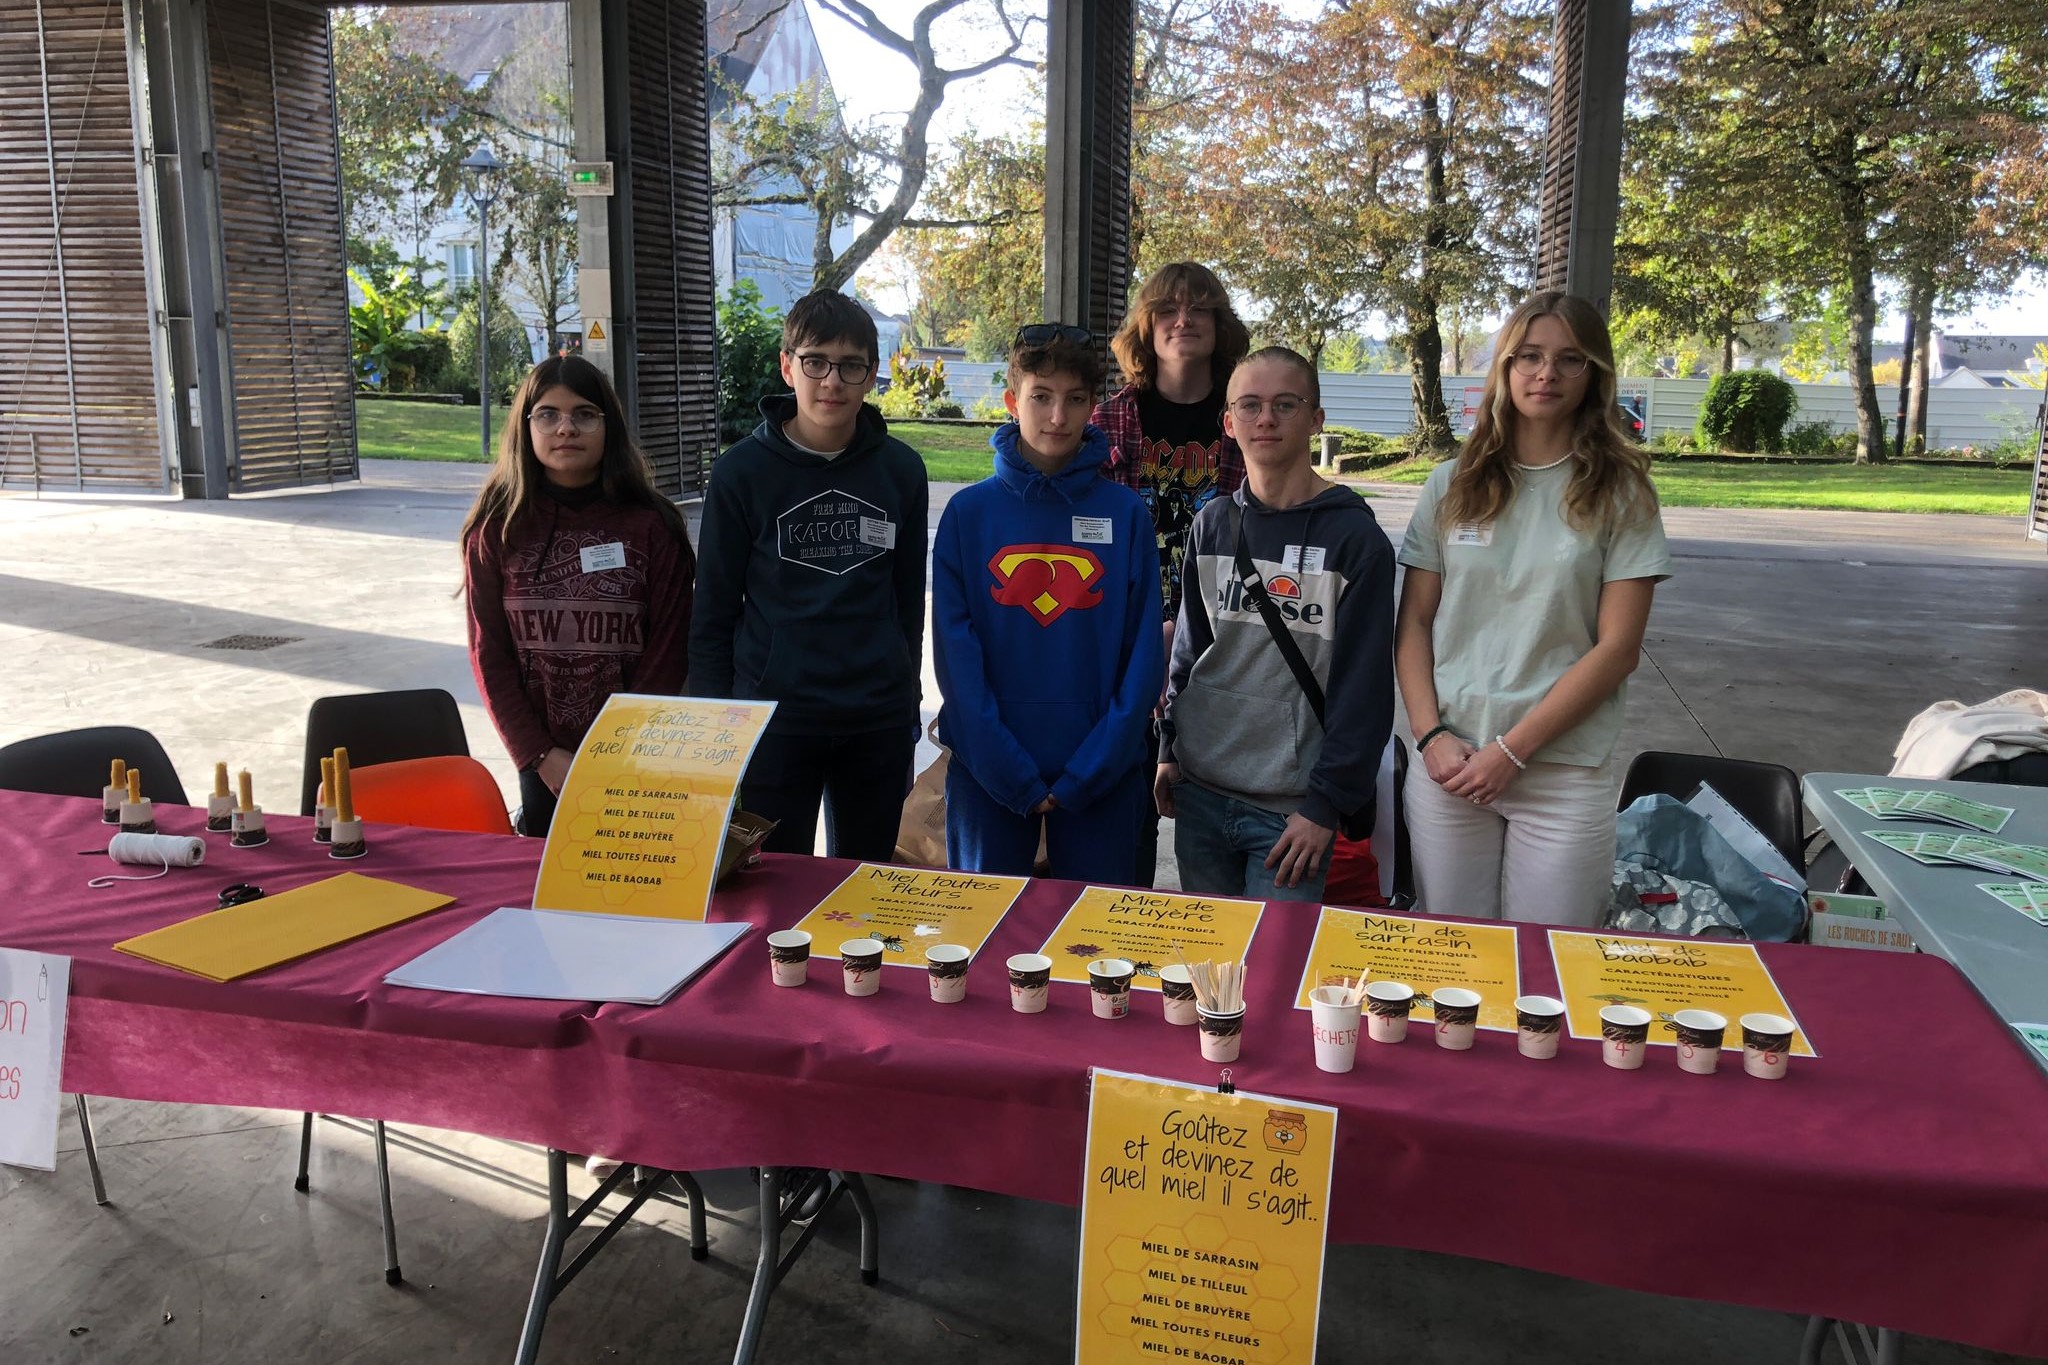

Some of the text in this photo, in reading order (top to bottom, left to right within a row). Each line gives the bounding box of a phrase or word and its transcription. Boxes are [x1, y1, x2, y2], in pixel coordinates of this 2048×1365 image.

[813, 502, 859, 516] FREE MIND
[788, 520, 861, 544] KAPOR
[839, 544, 854, 556] THE
[596, 579, 623, 595] 1896
[505, 609, 641, 645] NEW YORK
[560, 666, 570, 676] IS
[573, 662, 600, 676] MONEY
[647, 709, 709, 727] Goûtez
[614, 723, 736, 744] et devinez de
[589, 740, 626, 759] quel
[631, 741, 669, 757] miel
[673, 742, 687, 758] il
[604, 788, 689, 800] MIEL DE SARRASIN
[604, 808, 676, 820] MIEL DE TILLEUL
[595, 829, 674, 842] MIEL DE BRUYÈRE
[582, 850, 677, 864] MIEL TOUTES FLEURS
[586, 872, 662, 885] MIEL DE BAOBAB
[870, 869, 1001, 891] Miel toutes
[891, 882, 962, 899] fleurs
[871, 896, 974, 911] CARACTÉRISTIQUES
[1121, 893, 1215, 912] Miel de
[1109, 903, 1215, 923] bruyère
[1107, 919, 1216, 934] CARACTÉRISTIQUES
[1364, 917, 1467, 938] Miel de
[1171, 938, 1225, 947] BERGAMOTE
[1355, 931, 1472, 950] sarrasin
[1827, 925, 1842, 940] LES
[1844, 926, 1876, 944] RUCHES
[1878, 931, 1889, 945] DE
[1117, 947, 1171, 955] PERSISTANT
[1359, 944, 1478, 959] CARACTÉRISTIQUES
[1602, 950, 1708, 968] baobab
[1672, 945, 1706, 957] de
[1367, 961, 1410, 969] PERSISTE
[1428, 967, 1467, 975] BOUCHE
[1419, 958, 1462, 967] RÉGLISSE
[852, 970, 864, 984] 2
[931, 976, 940, 988] 3
[1605, 968, 1732, 982] CARACTÉRISTIQUES
[1012, 985, 1022, 997] 4
[1687, 991, 1730, 999] ACIDULÉ
[1615, 1041, 1630, 1057] 4
[1762, 1050, 1780, 1066] 6
[1161, 1109, 1249, 1149] Goûtez
[1123, 1135, 1299, 1188] et devinez de
[1100, 1164, 1146, 1195] quel
[1161, 1171, 1206, 1203] miel
[1222, 1180, 1232, 1207] il
[1141, 1241, 1260, 1271] MIEL DE SARRASIN
[1148, 1269, 1248, 1296] MIEL DE TILLEUL
[1142, 1293, 1251, 1322] MIEL DE BRUYÈRE
[1130, 1315, 1260, 1348] MIEL TOUTES FLEURS
[1142, 1341, 1245, 1365] MIEL DE BAOBAB
